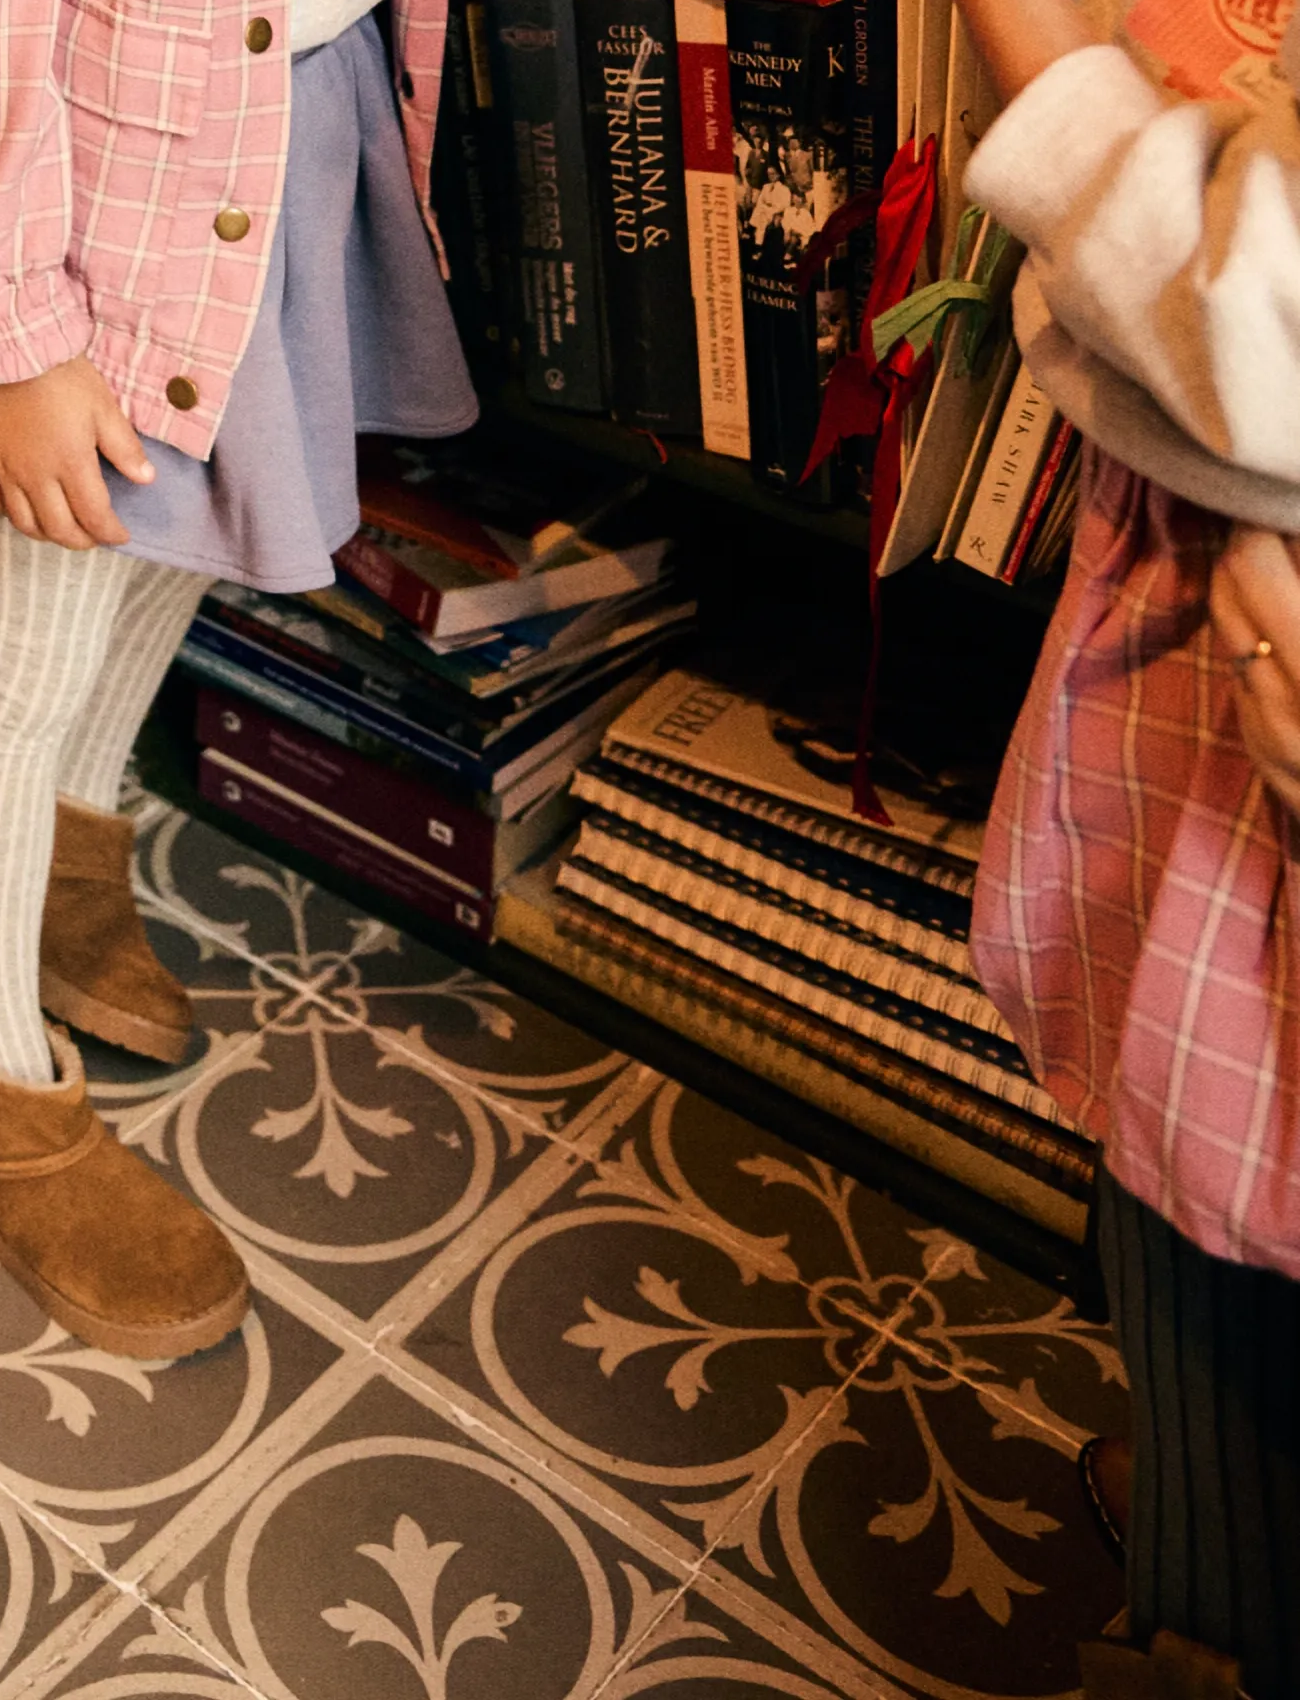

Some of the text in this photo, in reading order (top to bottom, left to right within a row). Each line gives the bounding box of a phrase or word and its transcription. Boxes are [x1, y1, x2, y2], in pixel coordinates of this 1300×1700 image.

[728, 49, 802, 74] KENNEDY
[744, 72, 782, 89] MEN
[854, 20, 870, 84] GRODEN
[600, 66, 642, 255] BERNHARD
[628, 75, 671, 213] JULIANA
[986, 443, 1026, 511] SHAW
